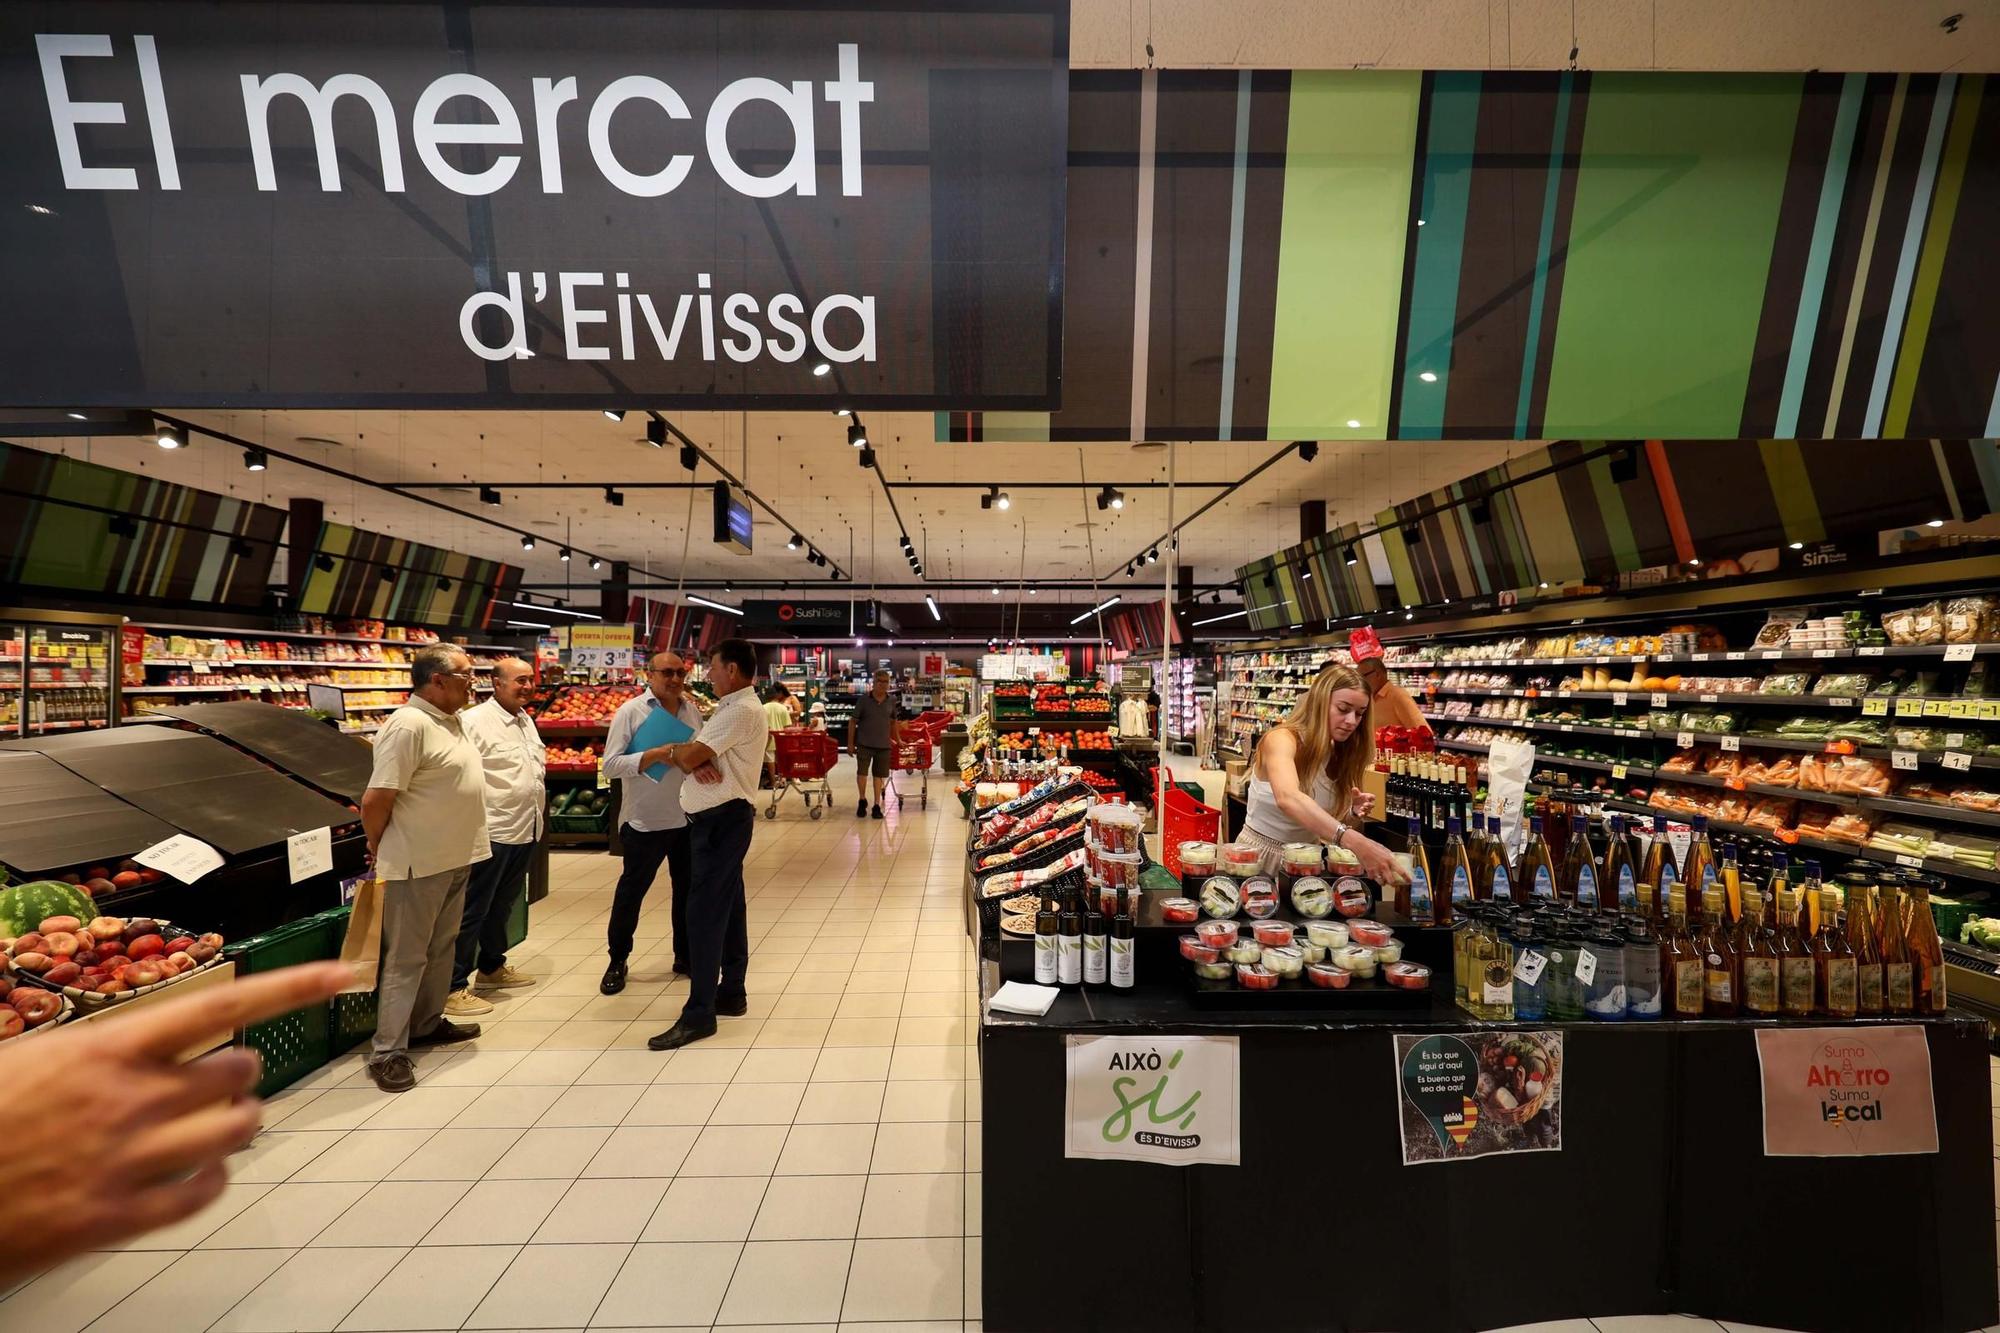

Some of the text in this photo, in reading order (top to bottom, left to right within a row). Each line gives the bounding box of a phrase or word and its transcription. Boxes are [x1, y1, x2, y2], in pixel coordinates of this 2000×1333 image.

[34, 33, 876, 198] El mercat
[458, 271, 877, 363] d'Eivissa
[1432, 1051, 1442, 1059] bo
[1444, 1052, 1459, 1060] que
[1824, 1045, 1865, 1058] Suma
[1108, 1047, 1162, 1071] AIXÒ
[1419, 1060, 1463, 1071] sigui d'aquí
[1417, 1075, 1425, 1083] Es
[1436, 1084, 1446, 1092] de
[1447, 1083, 1463, 1092] aquí
[1829, 1088, 1870, 1101] Suma
[1140, 1132, 1197, 1147] ÉS D'EIVISSA
